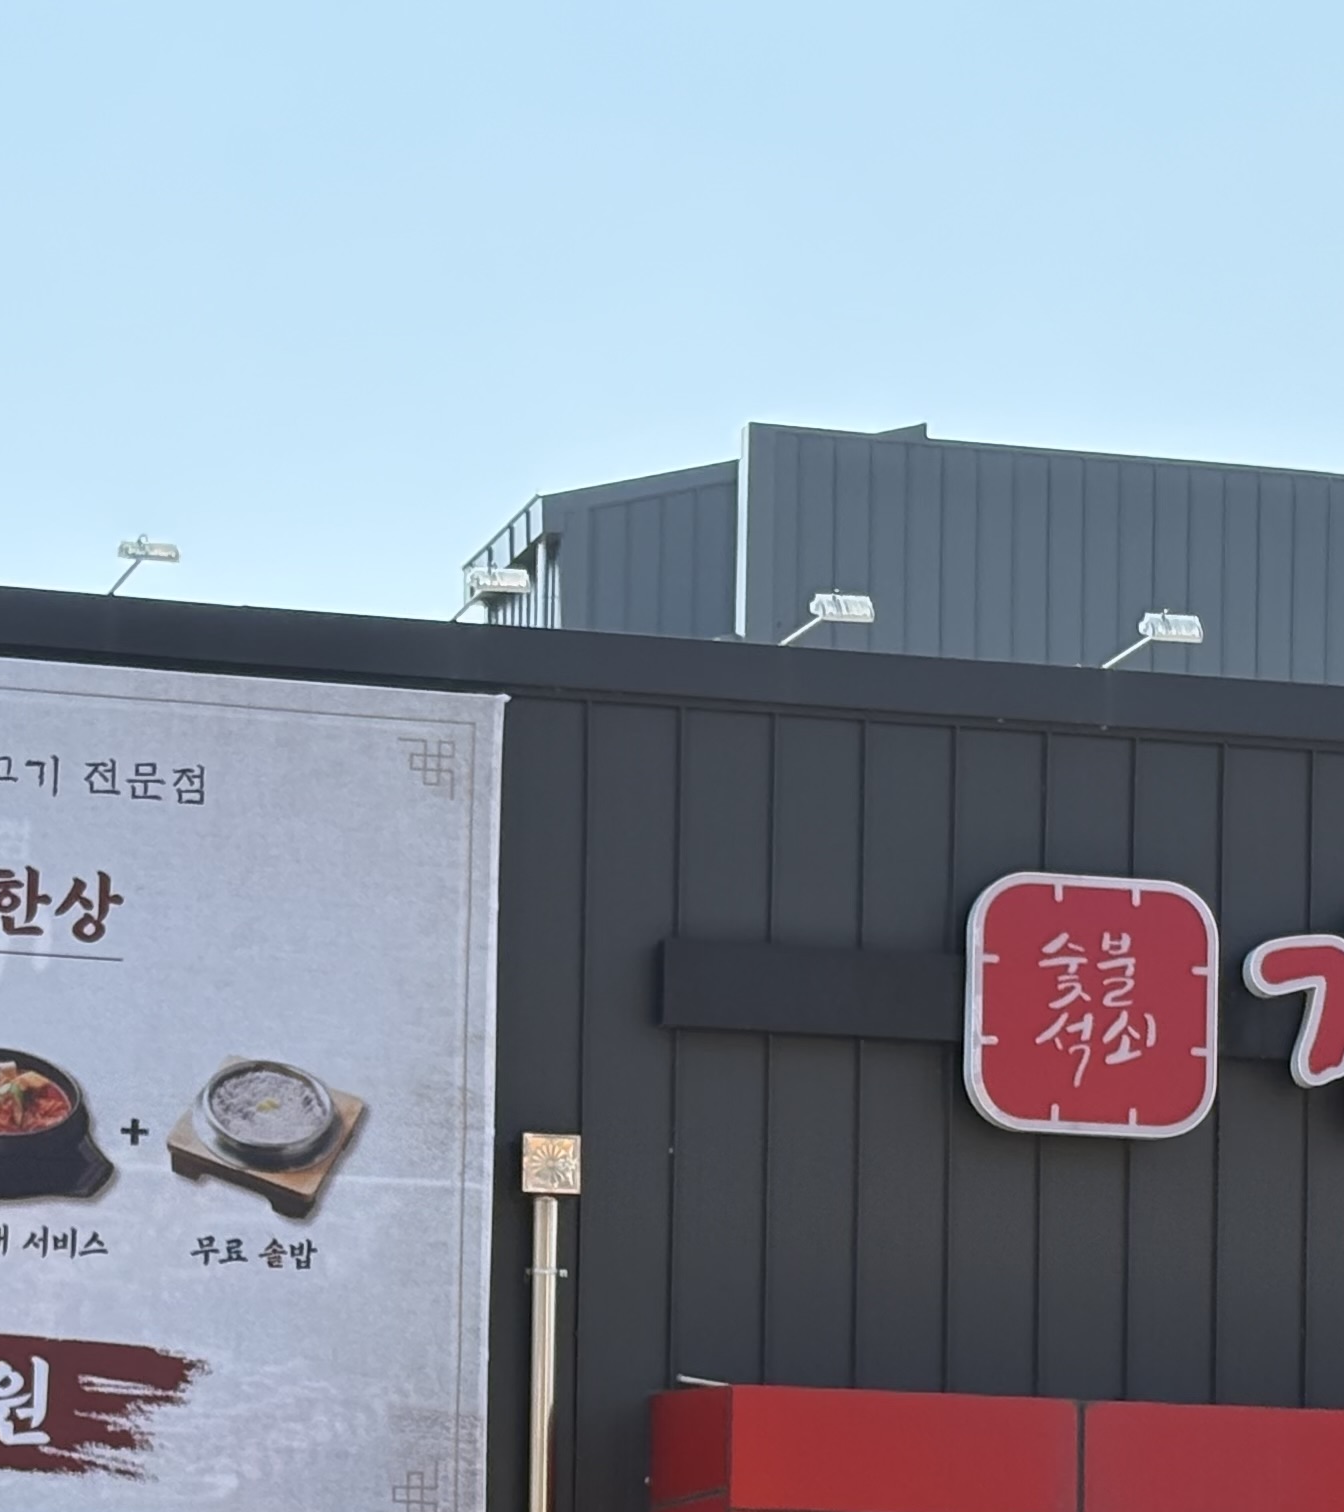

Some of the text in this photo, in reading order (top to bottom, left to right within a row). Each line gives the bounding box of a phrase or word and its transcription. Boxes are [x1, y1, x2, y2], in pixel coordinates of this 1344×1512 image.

[83, 757, 207, 806] 전문점
[1038, 931, 1137, 1009] 숯불
[1035, 1010, 1157, 1088] 석쇠
[22, 1225, 109, 1260] 서비스
[190, 1235, 318, 1270] 무료 솔밥
